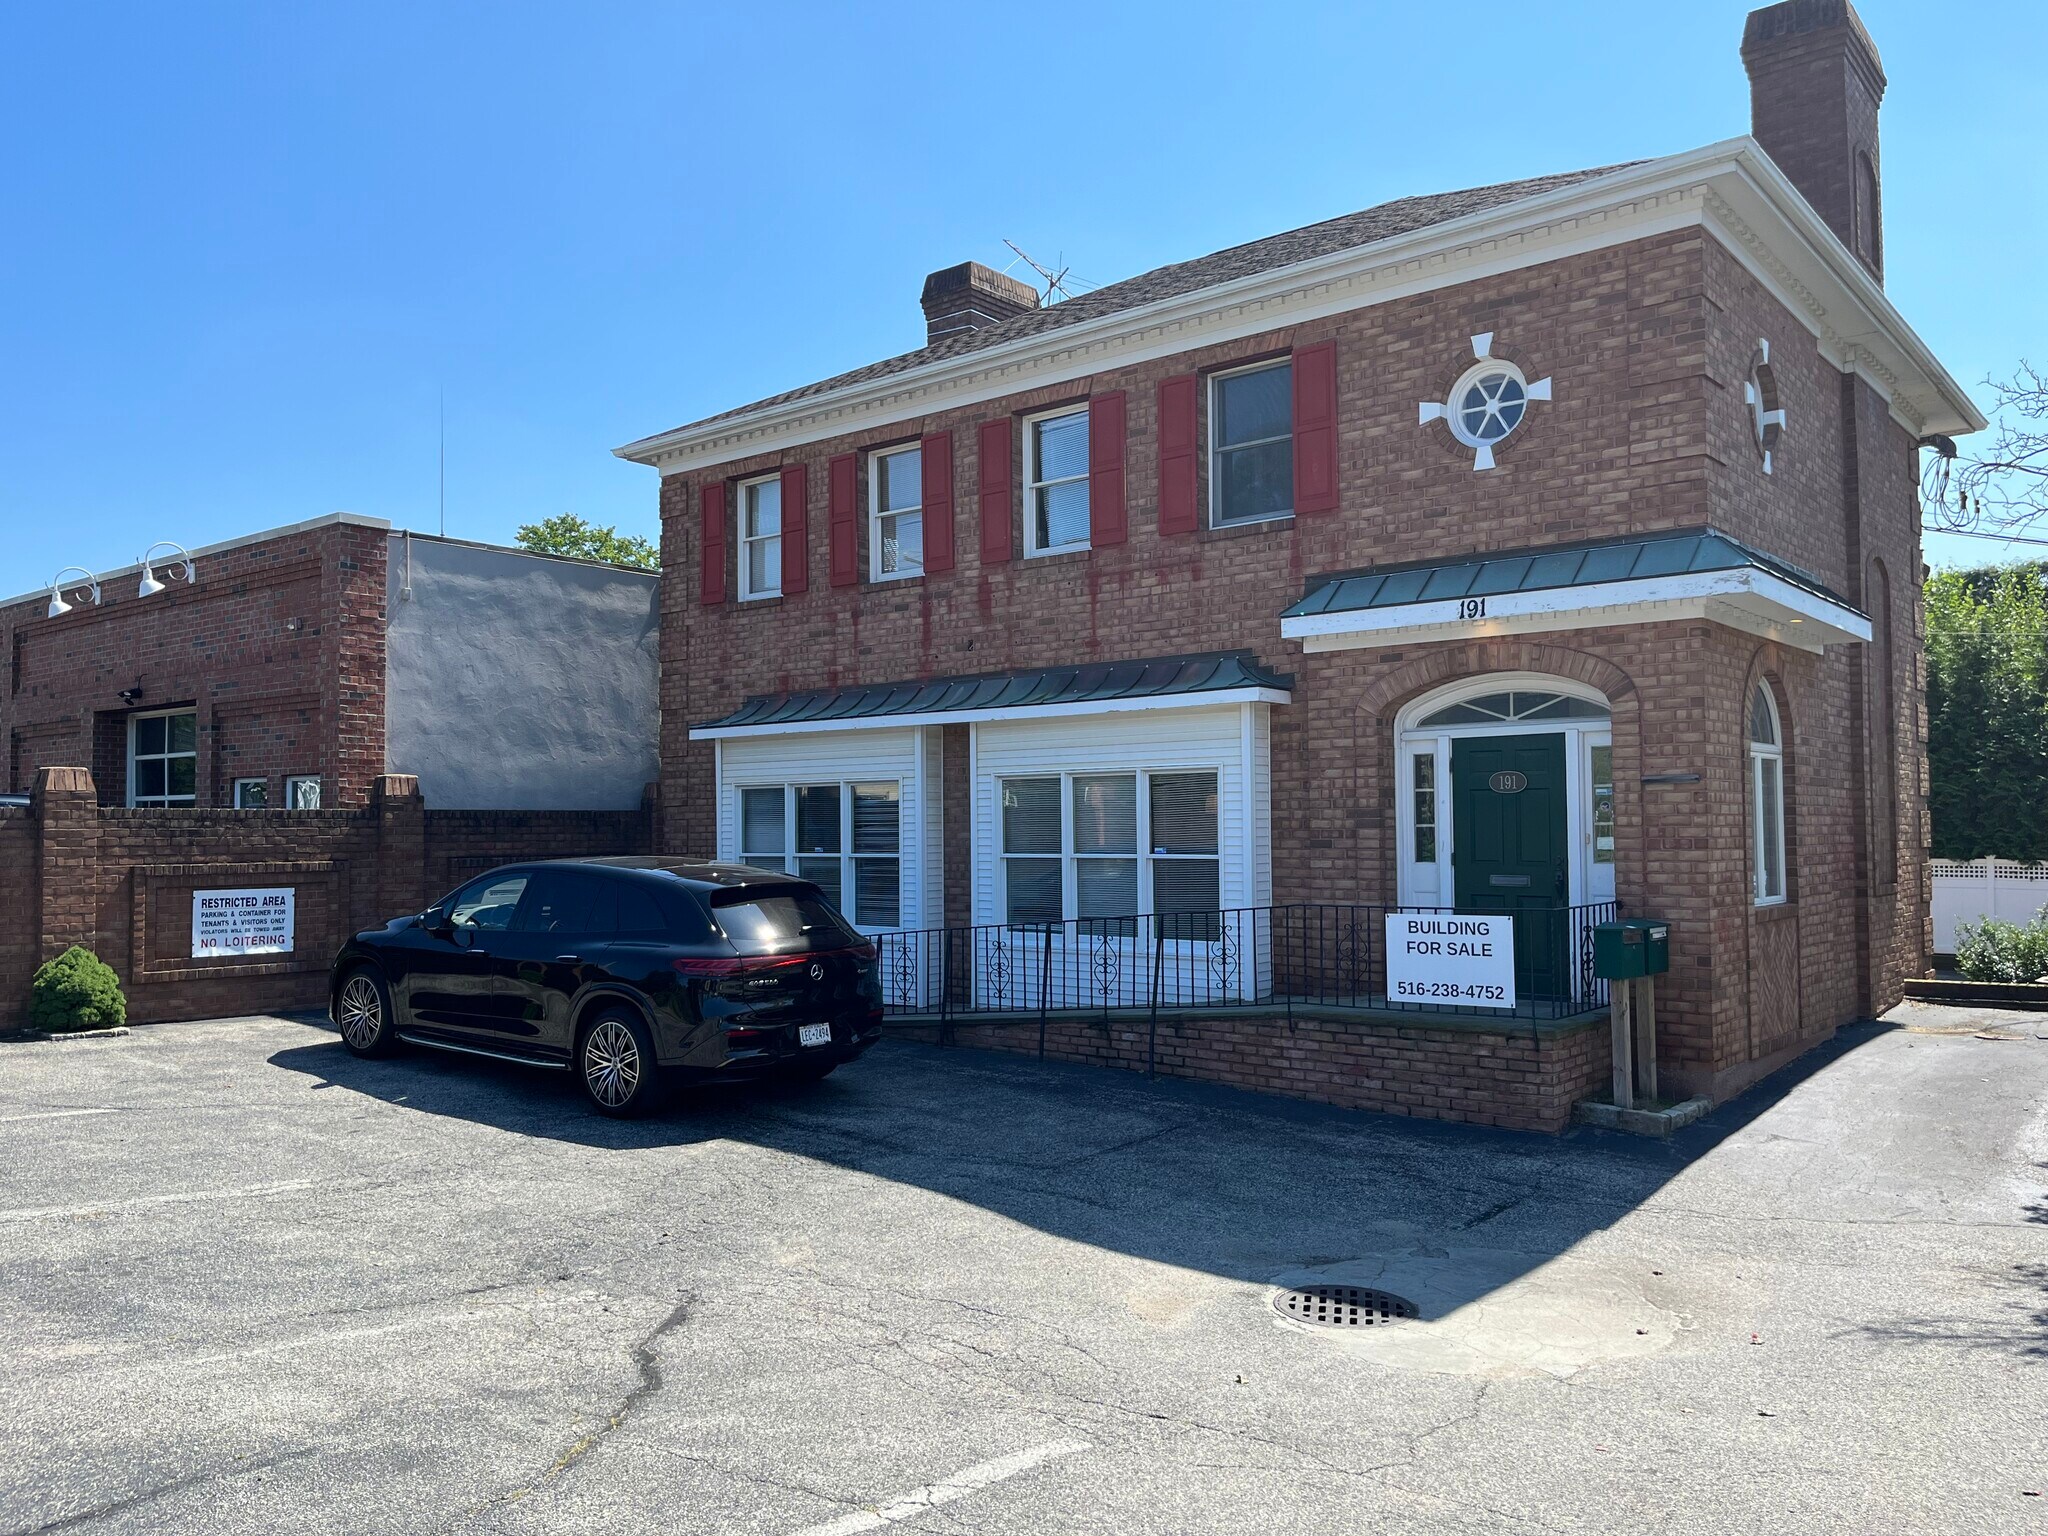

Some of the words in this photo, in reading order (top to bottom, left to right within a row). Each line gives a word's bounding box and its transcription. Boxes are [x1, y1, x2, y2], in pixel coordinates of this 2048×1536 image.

[1459, 597, 1486, 620] 191
[1499, 775, 1518, 790] 191
[201, 896, 258, 909] RESTRICTED
[262, 895, 286, 907] AREA
[238, 909, 271, 917] CONTAINER
[201, 919, 229, 928] TENANTS
[240, 918, 267, 926] VISITORS
[1407, 920, 1490, 936] BUILDING
[200, 938, 217, 948] NO
[224, 934, 285, 947] LOITERING
[1406, 940, 1442, 955] FOR
[1446, 942, 1493, 957] SALE
[1397, 981, 1505, 1000] 516-238-4752
